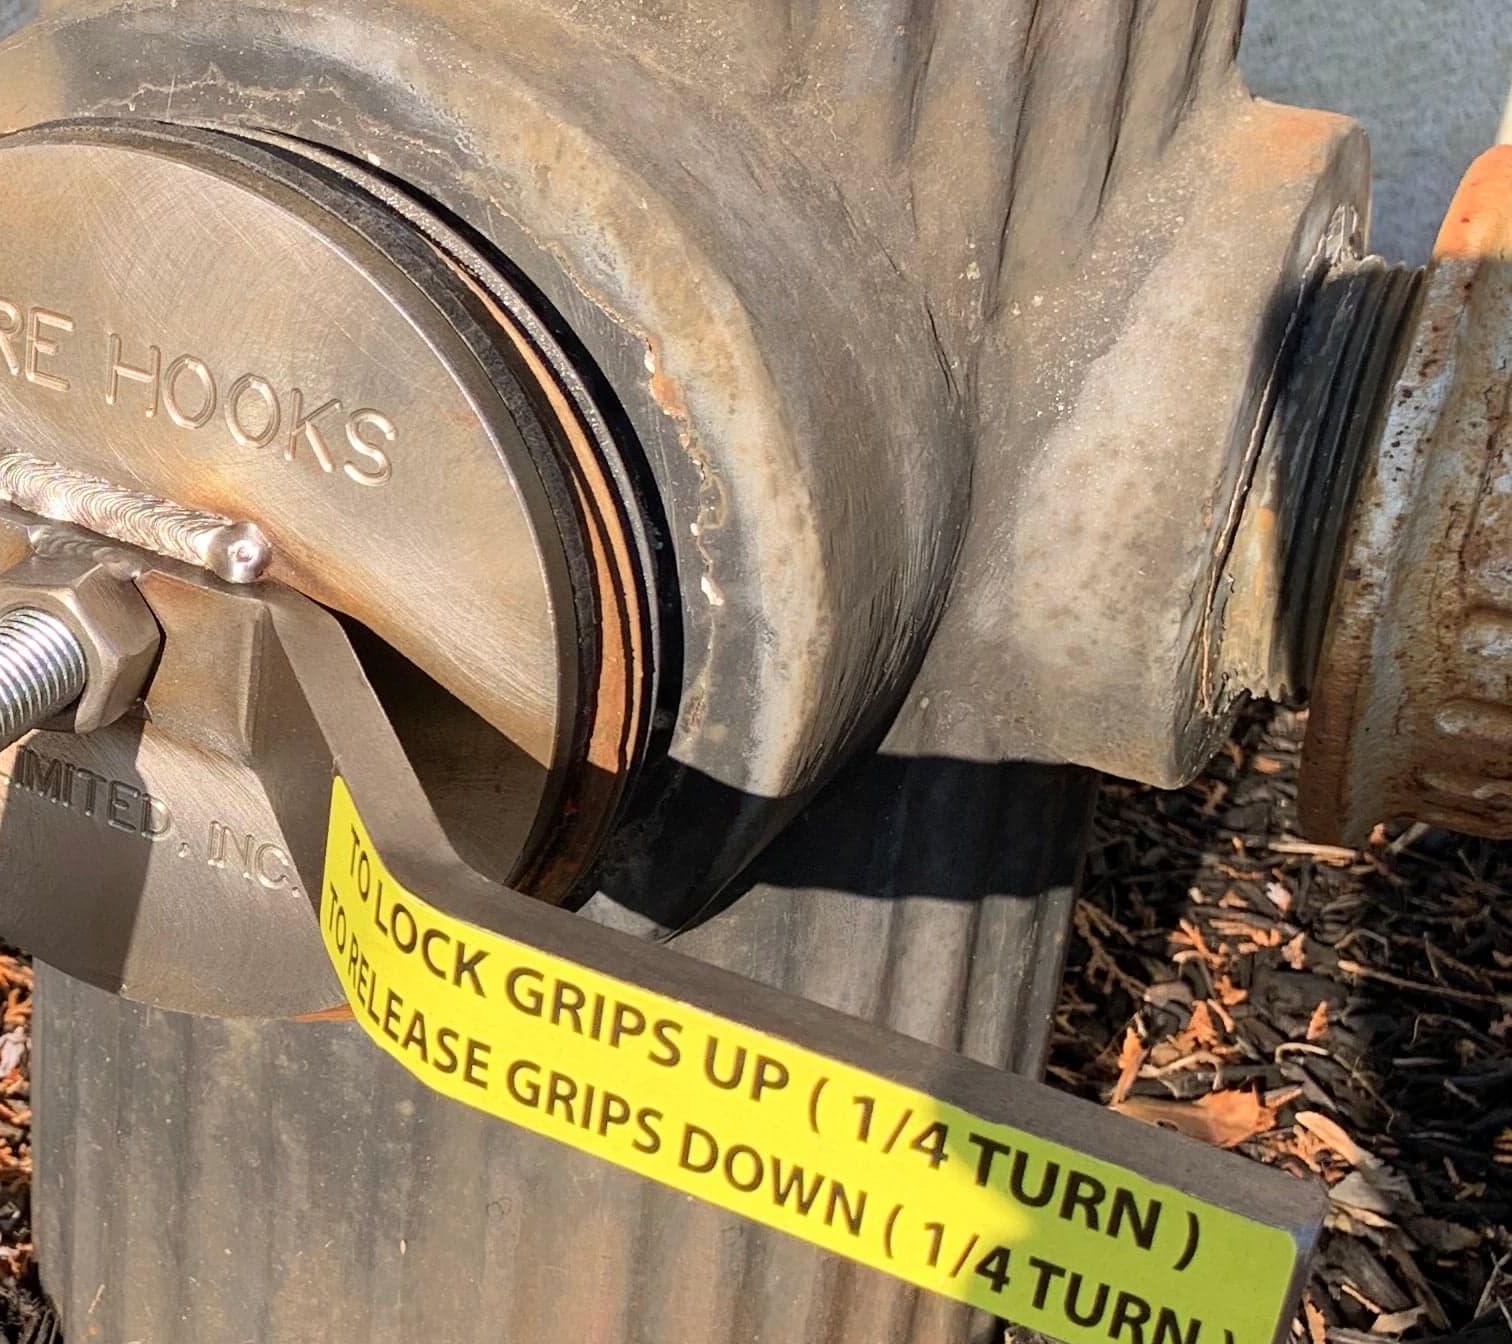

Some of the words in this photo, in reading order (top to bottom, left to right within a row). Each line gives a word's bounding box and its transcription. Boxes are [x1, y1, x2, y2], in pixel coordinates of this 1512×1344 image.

[105, 331, 398, 487] HOOKS
[206, 819, 301, 898] INC.
[350, 824, 371, 902] TO
[375, 879, 491, 998] LOCK
[504, 966, 684, 1068] GRIPS
[704, 1034, 789, 1103] UP
[328, 880, 347, 953] TO
[347, 934, 491, 1090] RELEASE
[506, 1059, 664, 1155] GRIPS
[678, 1122, 868, 1237] DOWN
